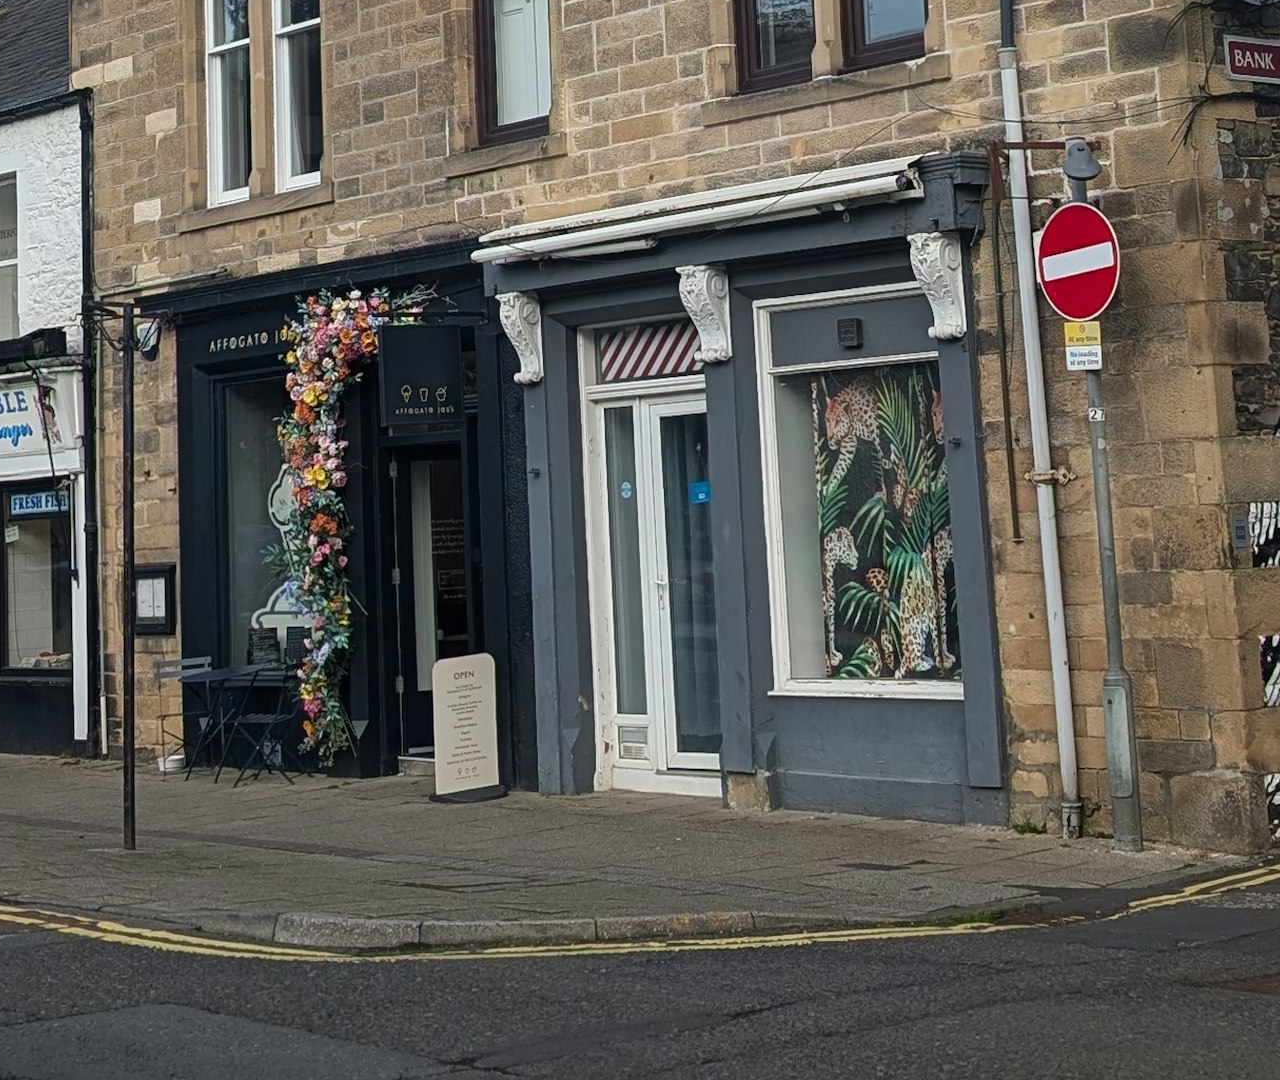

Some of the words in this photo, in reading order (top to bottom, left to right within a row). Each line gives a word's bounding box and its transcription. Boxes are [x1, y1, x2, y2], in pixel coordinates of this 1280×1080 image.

[1234, 49, 1275, 71] BANK
[209, 331, 269, 352] AFFOGATO
[1078, 350, 1098, 358] loading
[1087, 358, 1099, 366] time
[13, 494, 43, 511] FRESH
[453, 670, 475, 680] OPEN
